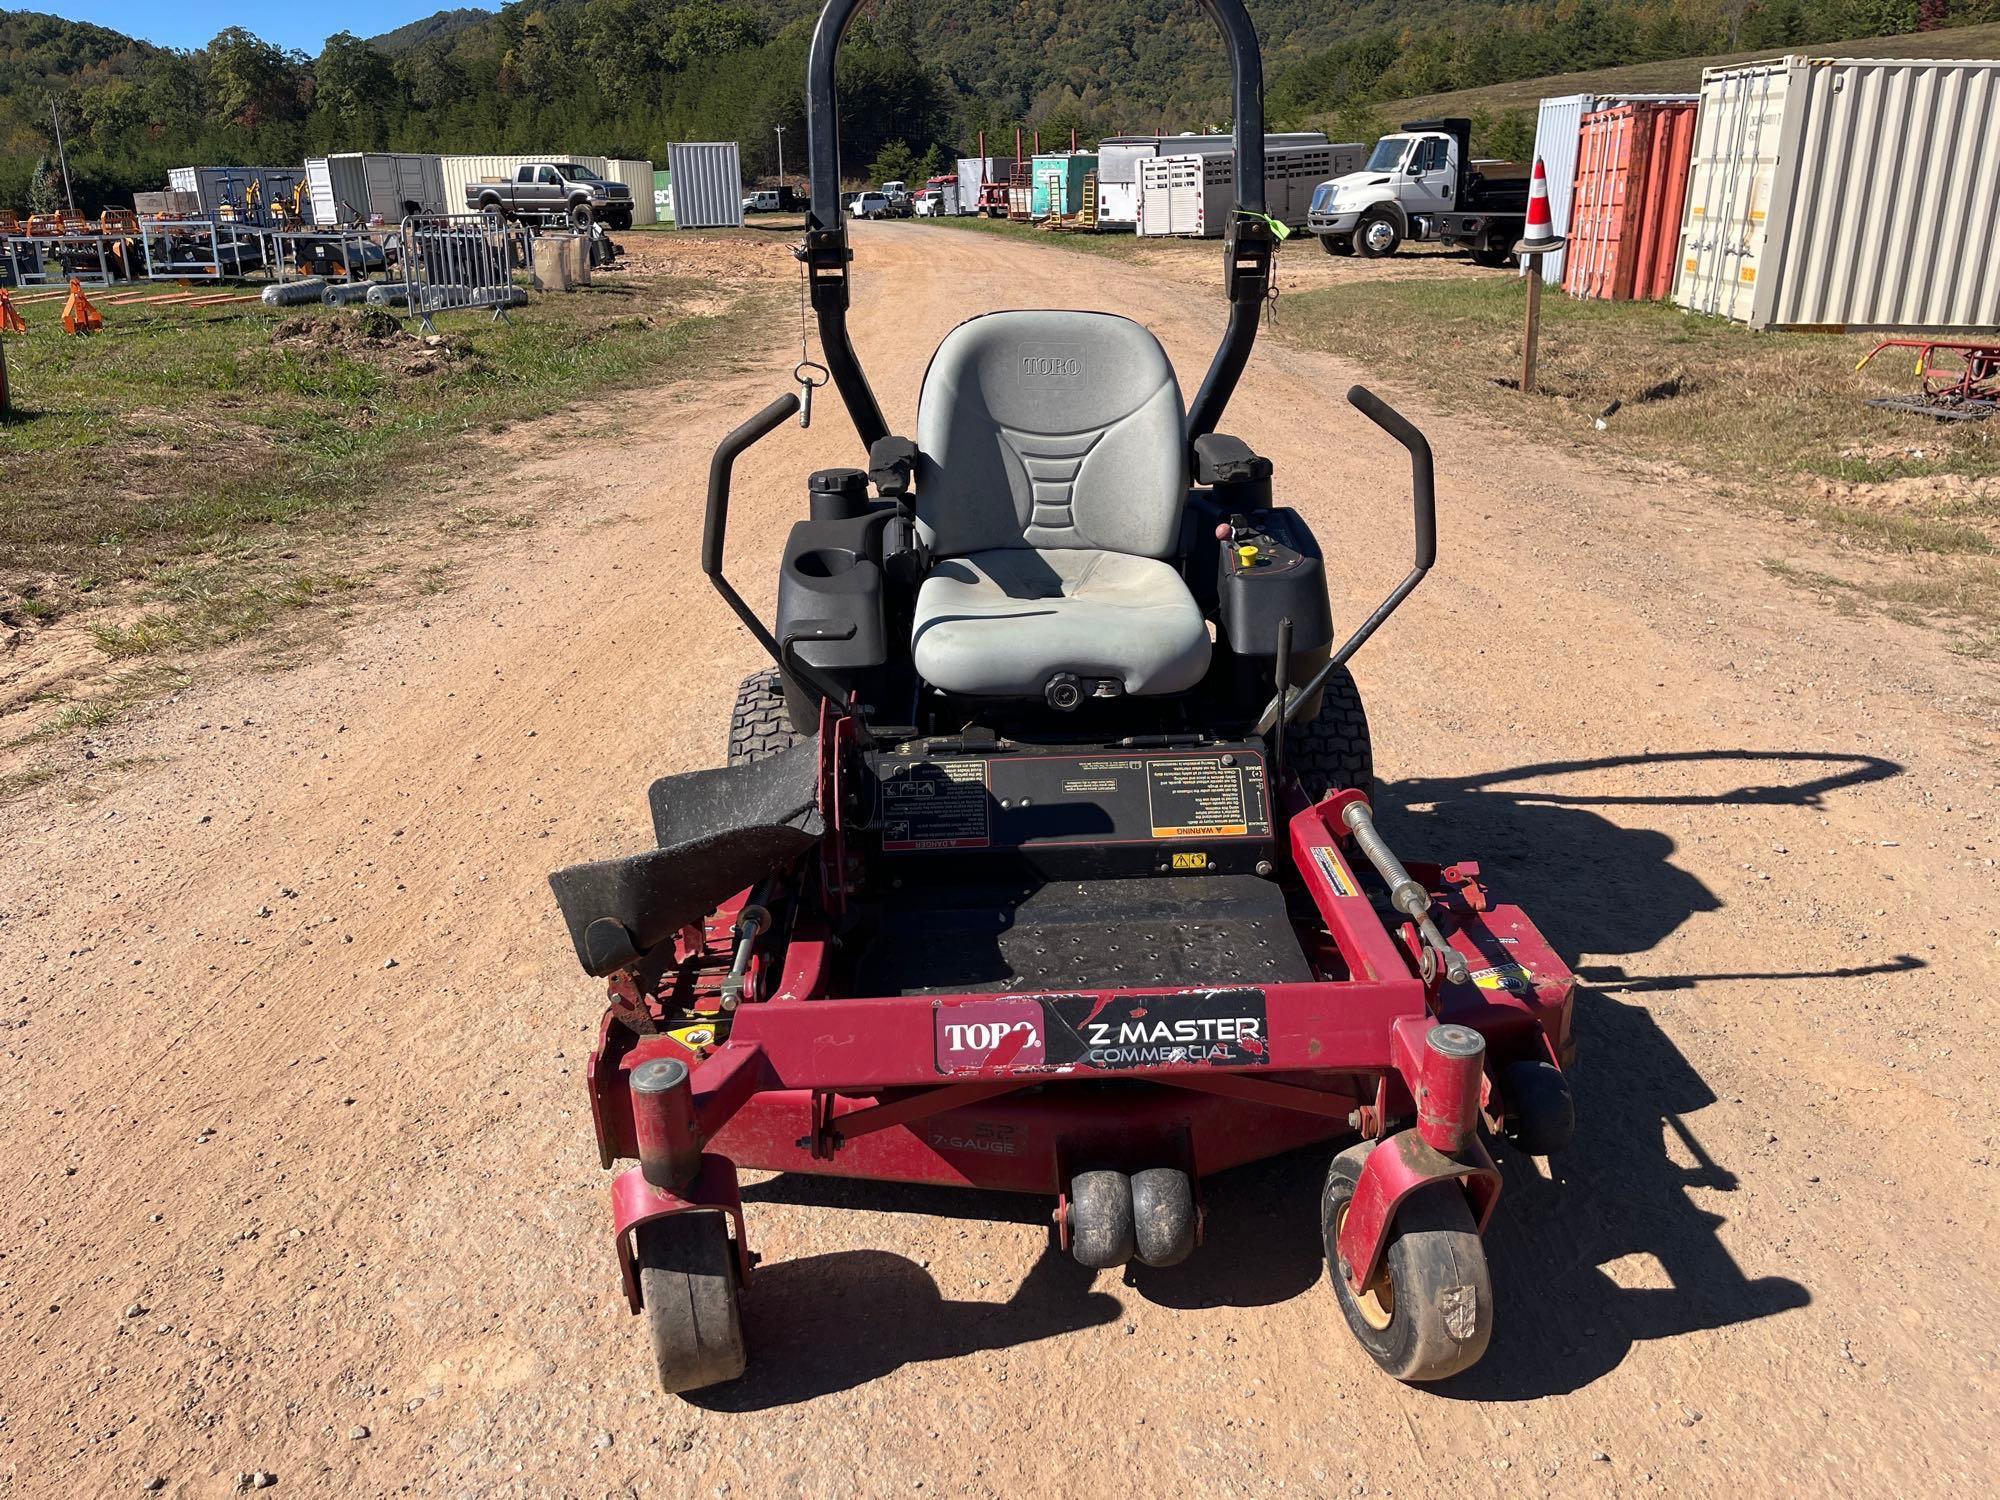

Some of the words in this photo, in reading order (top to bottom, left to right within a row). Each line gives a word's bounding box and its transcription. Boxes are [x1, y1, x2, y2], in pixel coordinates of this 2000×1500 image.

[1023, 357, 1082, 377] TORO
[915, 841, 948, 849] DANGER
[1471, 962, 1518, 979] DANGER
[1088, 1023, 1111, 1044] Z
[1119, 1017, 1260, 1043] MASTER
